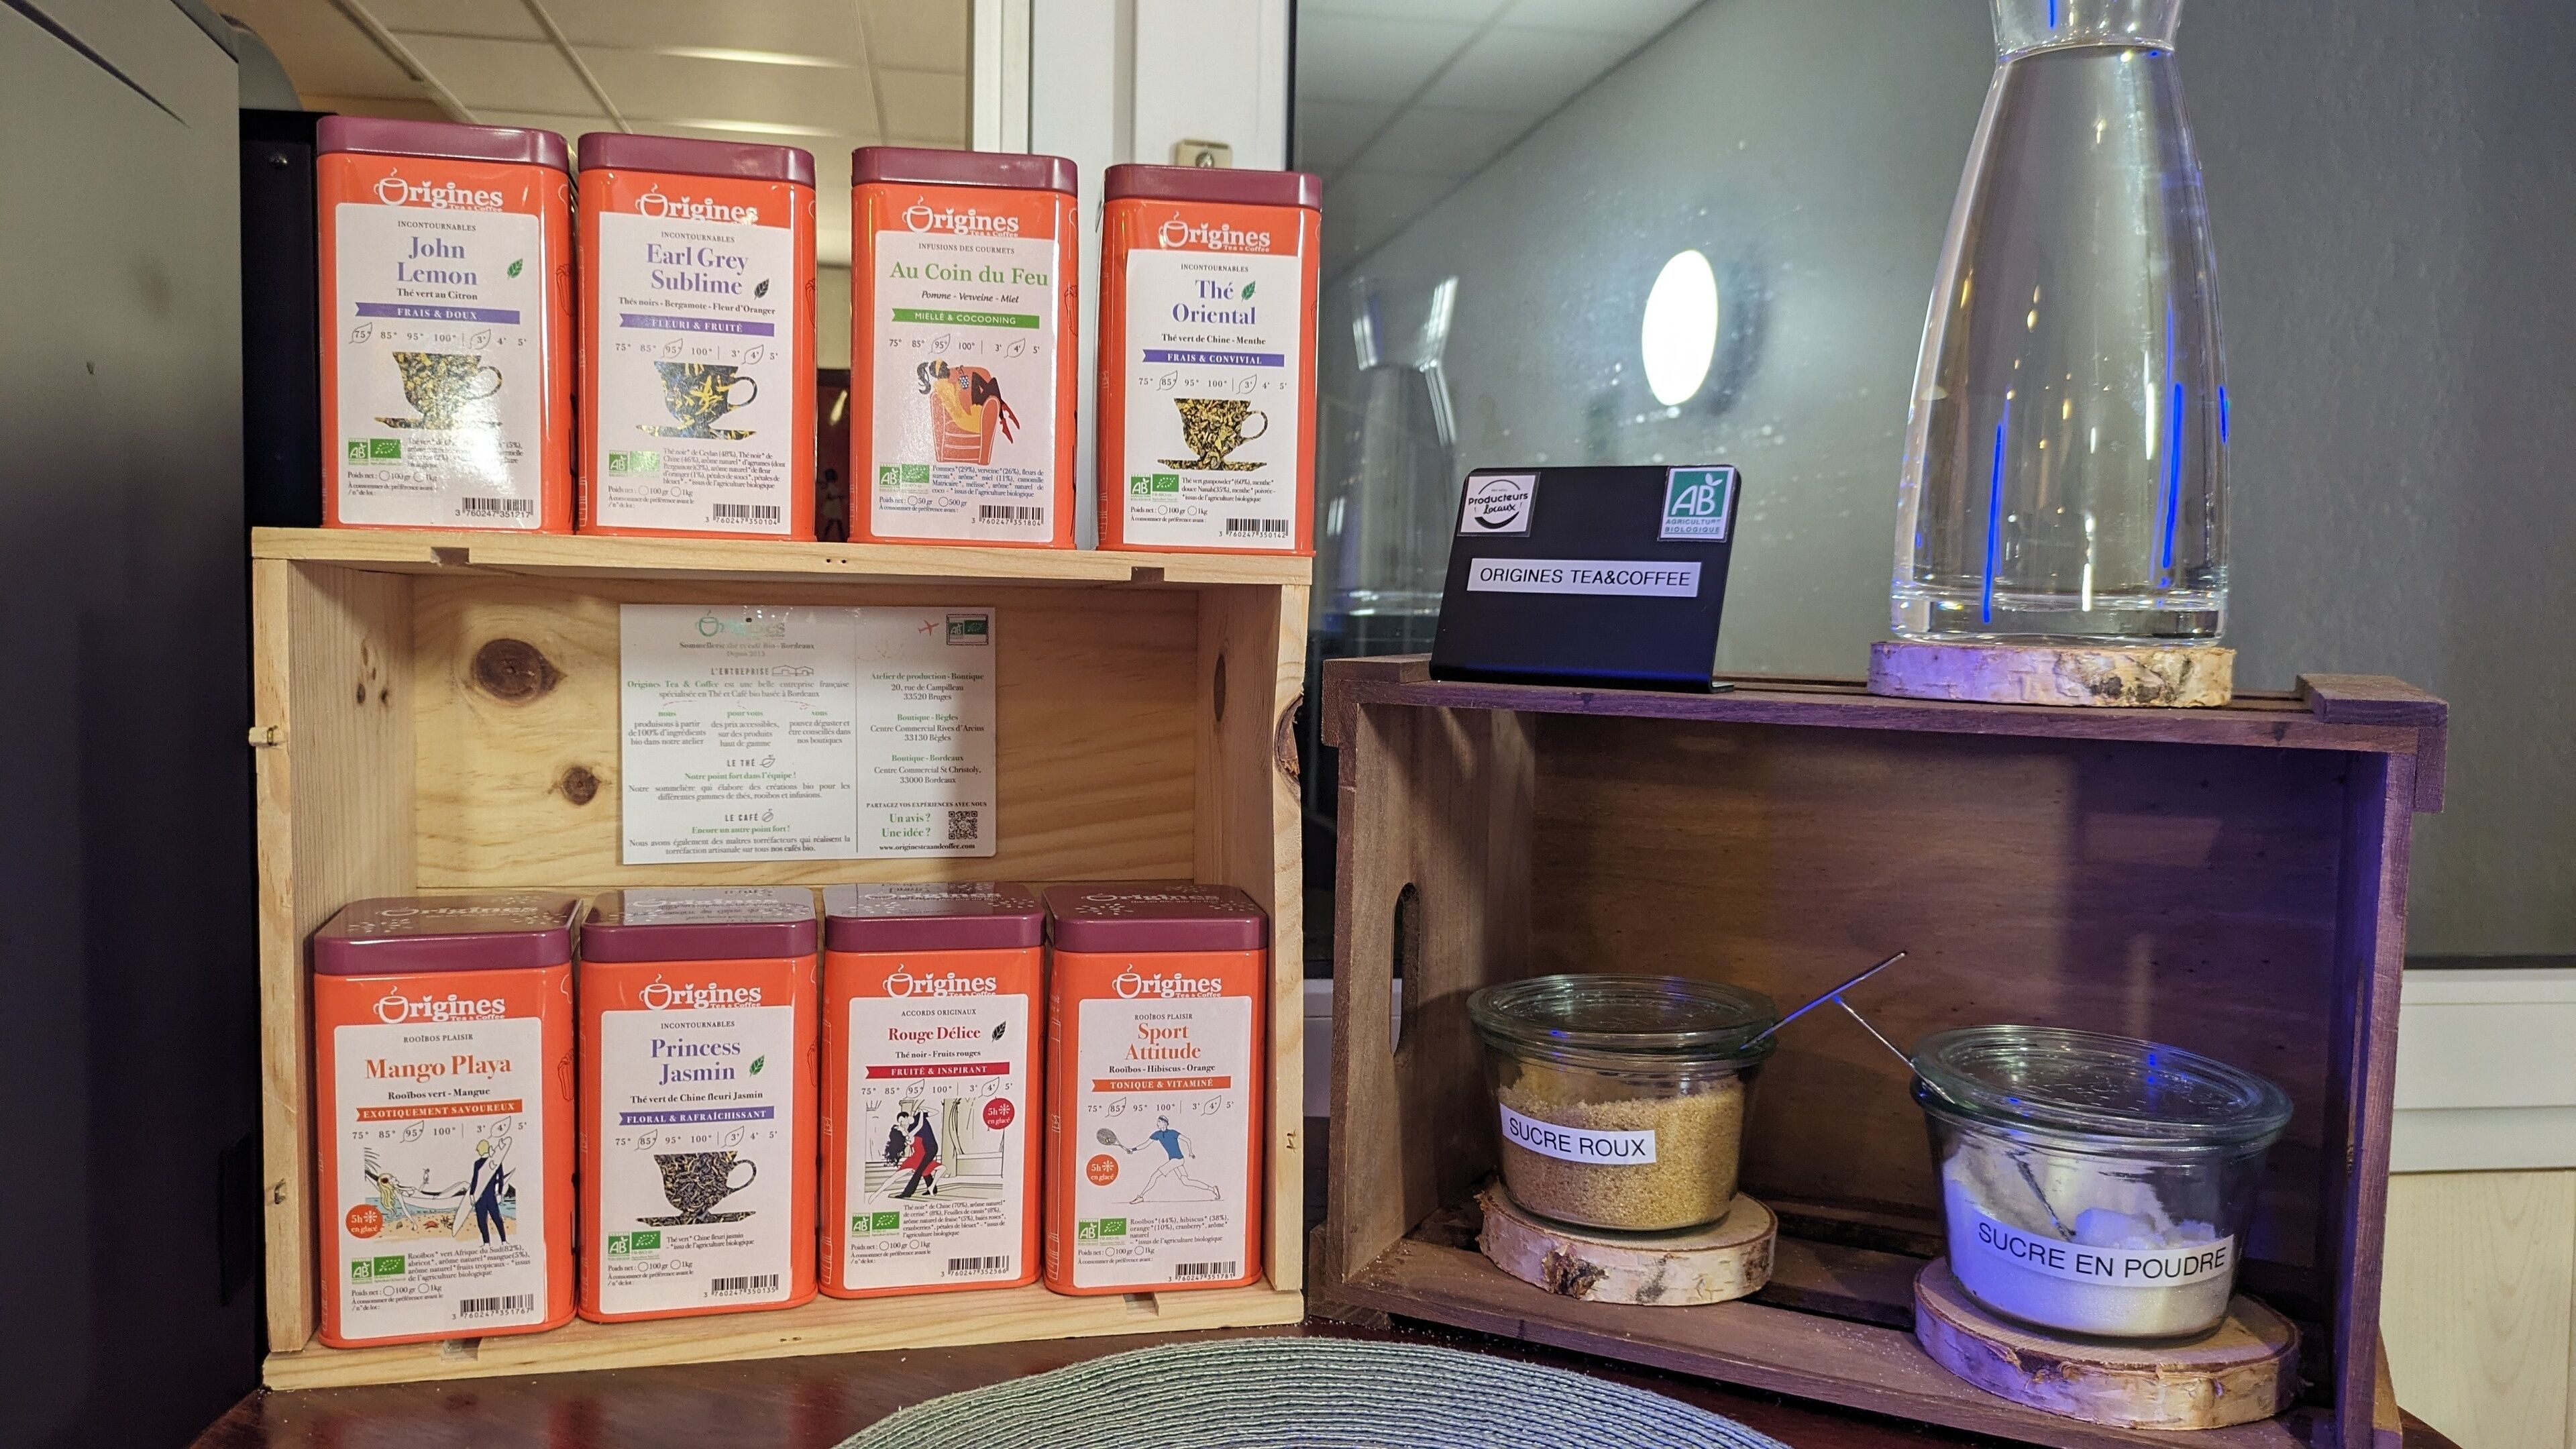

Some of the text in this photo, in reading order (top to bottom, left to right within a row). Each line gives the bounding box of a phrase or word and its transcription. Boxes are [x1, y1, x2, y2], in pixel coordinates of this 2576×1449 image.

[374, 178, 503, 209] Origines
[635, 193, 759, 224] Origines
[398, 221, 476, 231] INCONTOURNABLES
[902, 205, 1019, 235] Origines
[661, 231, 735, 243] INCONTOURNABLES
[1159, 221, 1271, 250] Origines
[409, 236, 466, 259] John
[918, 243, 958, 252] INFUSIONS
[975, 246, 1014, 254] GOURMETS
[647, 244, 749, 275] Earl Grey
[397, 262, 478, 285] Lemon
[890, 262, 1049, 286] Au Coin du Feu
[1181, 264, 1248, 272] INCONTOURNABLES
[651, 270, 743, 295] Sublime
[1195, 280, 1234, 299] Thé
[397, 288, 414, 297] Thé
[448, 291, 478, 301] Citron
[922, 291, 1019, 303] Pomme Verveine Miel
[619, 297, 637, 305] Thés
[665, 300, 706, 311] Bergamote
[713, 303, 734, 312] Fleur
[397, 308, 430, 317] FRAIS
[446, 311, 477, 319] DOUX
[915, 311, 944, 321] MIELLÉ
[957, 314, 1016, 325] COCOONING
[1173, 303, 1256, 325] Oriental
[651, 318, 690, 329] FLEURI
[704, 321, 743, 333] FRUITÉ
[1161, 333, 1177, 341] Thé
[1207, 335, 1230, 344] Chine
[1236, 337, 1266, 345] Menthe
[1167, 354, 1196, 362] FRAIS
[1210, 355, 1262, 364] CONVIVIAL
[1468, 493, 1528, 505] Producteurs
[1671, 485, 1715, 515] AB
[1483, 504, 1515, 514] Locaux
[1480, 567, 1691, 586] ORIGINES TEA&COFFEE
[926, 684, 963, 694] Campilleau
[928, 693, 952, 702] Bruges
[741, 758, 755, 767] THÉ
[739, 813, 758, 822] CAFÉ
[890, 814, 904, 822] Un
[906, 814, 924, 822] avis
[881, 828, 902, 837] Une
[904, 828, 924, 837] idée
[883, 973, 997, 998] Origines
[1112, 973, 1222, 998] Origines
[639, 983, 761, 1010] Origines
[373, 996, 506, 1024] Origines
[661, 1021, 735, 1029] INCONTOURNABLES
[888, 1026, 981, 1044] Rouge Délice
[1138, 1022, 1189, 1044] Sport
[651, 1038, 741, 1058] Princess
[911, 1051, 927, 1059] noir
[957, 1050, 981, 1059] rouges
[1125, 1042, 1201, 1060] Attitude
[365, 1055, 512, 1083] Mango Playa
[659, 1061, 735, 1085] Jasmin
[891, 1067, 924, 1076] FRUITÉ
[938, 1066, 987, 1075] INSPIRANT
[1109, 1065, 1141, 1073] Rooïbos
[1187, 1064, 1216, 1073] Orange
[1110, 1081, 1154, 1089] TONIQUE
[1167, 1079, 1214, 1088] VITAMINÉ
[388, 1090, 426, 1100] Rooïbos
[453, 1088, 490, 1099] Mangue
[631, 1095, 648, 1104] Thé
[680, 1093, 706, 1102] Chine
[708, 1092, 731, 1100] fleuri
[734, 1090, 763, 1100] Jasmin
[363, 1102, 515, 1118] EXOTIQUEMENT SAVOUREUX
[627, 1115, 666, 1124] FLORAL
[669, 1114, 676, 1122] &
[1509, 1118, 1646, 1157] SUCRE ROUX
[1091, 1163, 1102, 1171] 5h
[351, 1215, 362, 1224] 5h
[1978, 1222, 2226, 1279] SUCRE EN POUDRE
